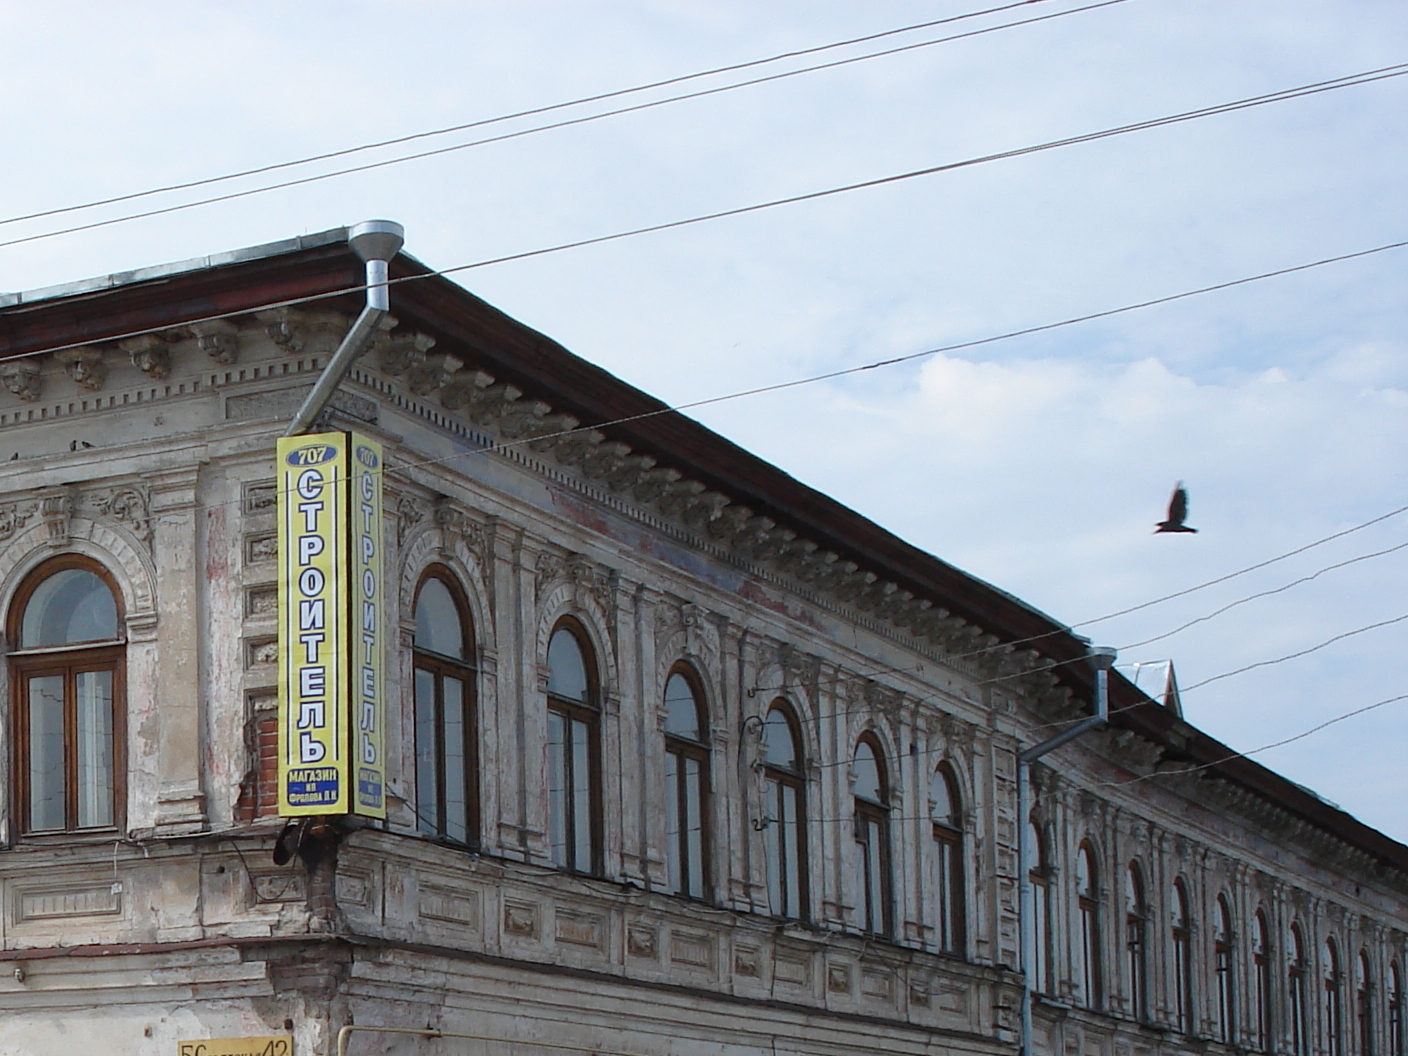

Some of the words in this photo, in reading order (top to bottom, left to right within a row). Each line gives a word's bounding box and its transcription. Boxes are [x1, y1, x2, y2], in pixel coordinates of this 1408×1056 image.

[298, 447, 327, 465] 707
[296, 469, 325, 763] СТРОИТЕЛЬ
[360, 471, 376, 765] СТРОИТЕЛЬ
[289, 769, 336, 782] МАГАЗИН
